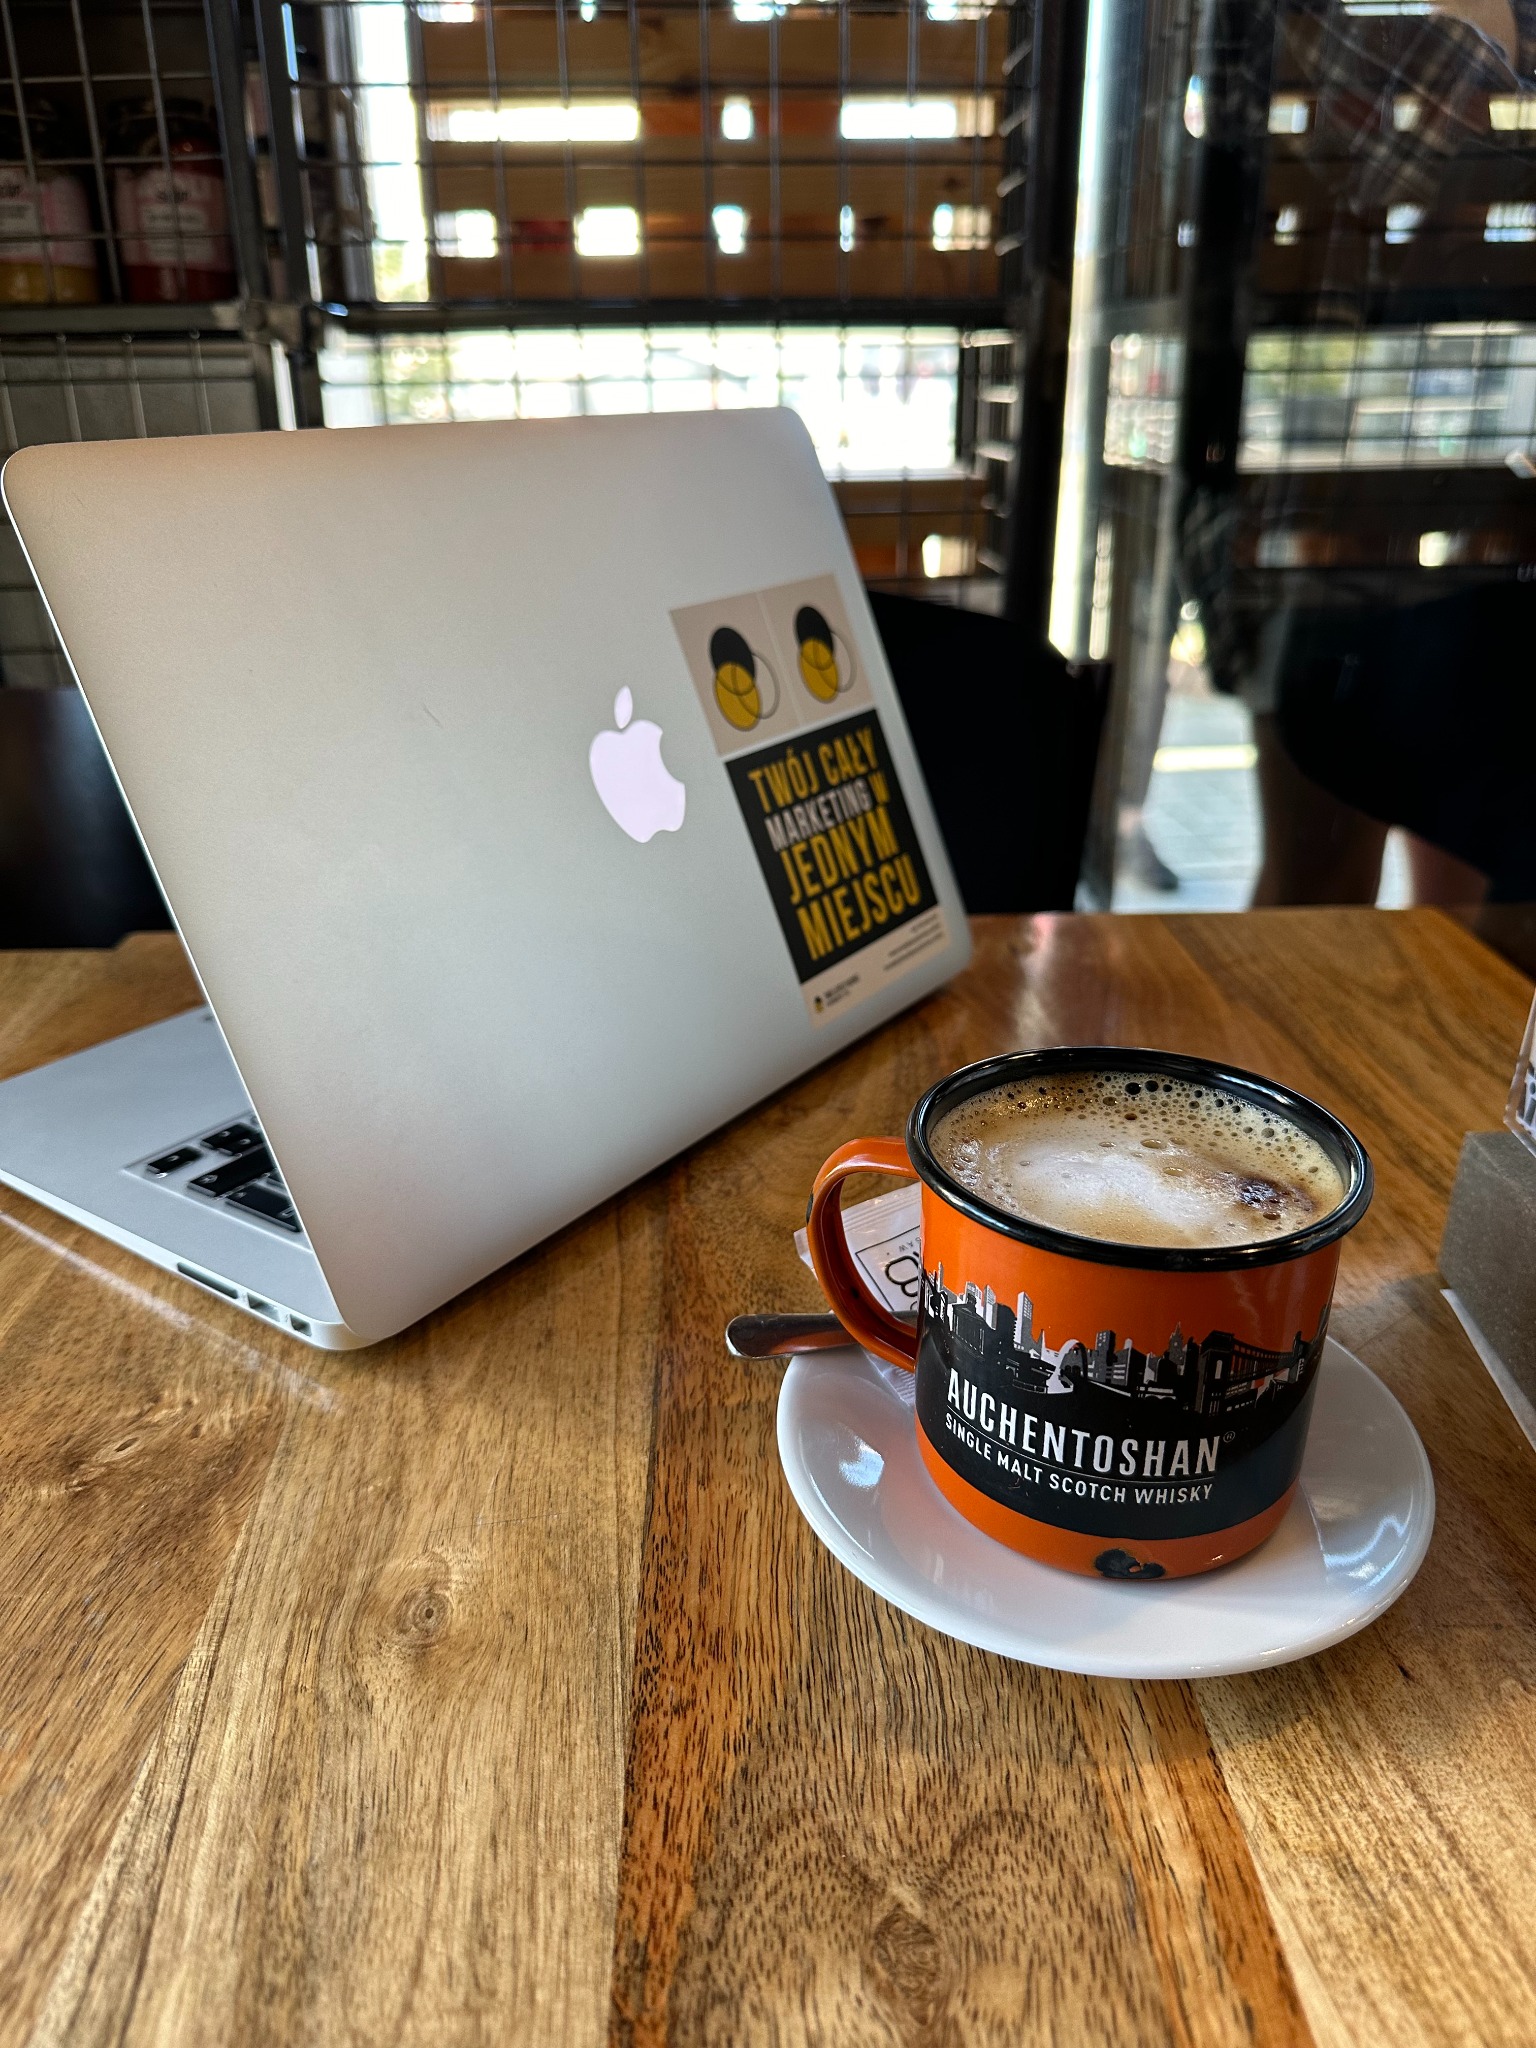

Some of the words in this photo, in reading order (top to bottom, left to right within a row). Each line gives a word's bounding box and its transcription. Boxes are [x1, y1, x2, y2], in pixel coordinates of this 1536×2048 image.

[747, 745, 820, 814] TWÓJ
[818, 726, 878, 786] CAŁY
[764, 777, 873, 851] MARKETING
[867, 771, 890, 805] W
[779, 806, 899, 905] JEDNYM
[796, 853, 922, 961] MIEJSCU
[945, 1412, 992, 1461] SINGLE
[997, 1453, 1043, 1484] MALT
[1049, 1473, 1126, 1504] SCOTCH
[1134, 1483, 1213, 1504] WHISKY
[947, 1367, 1220, 1477] AUCHENTOSHAN
